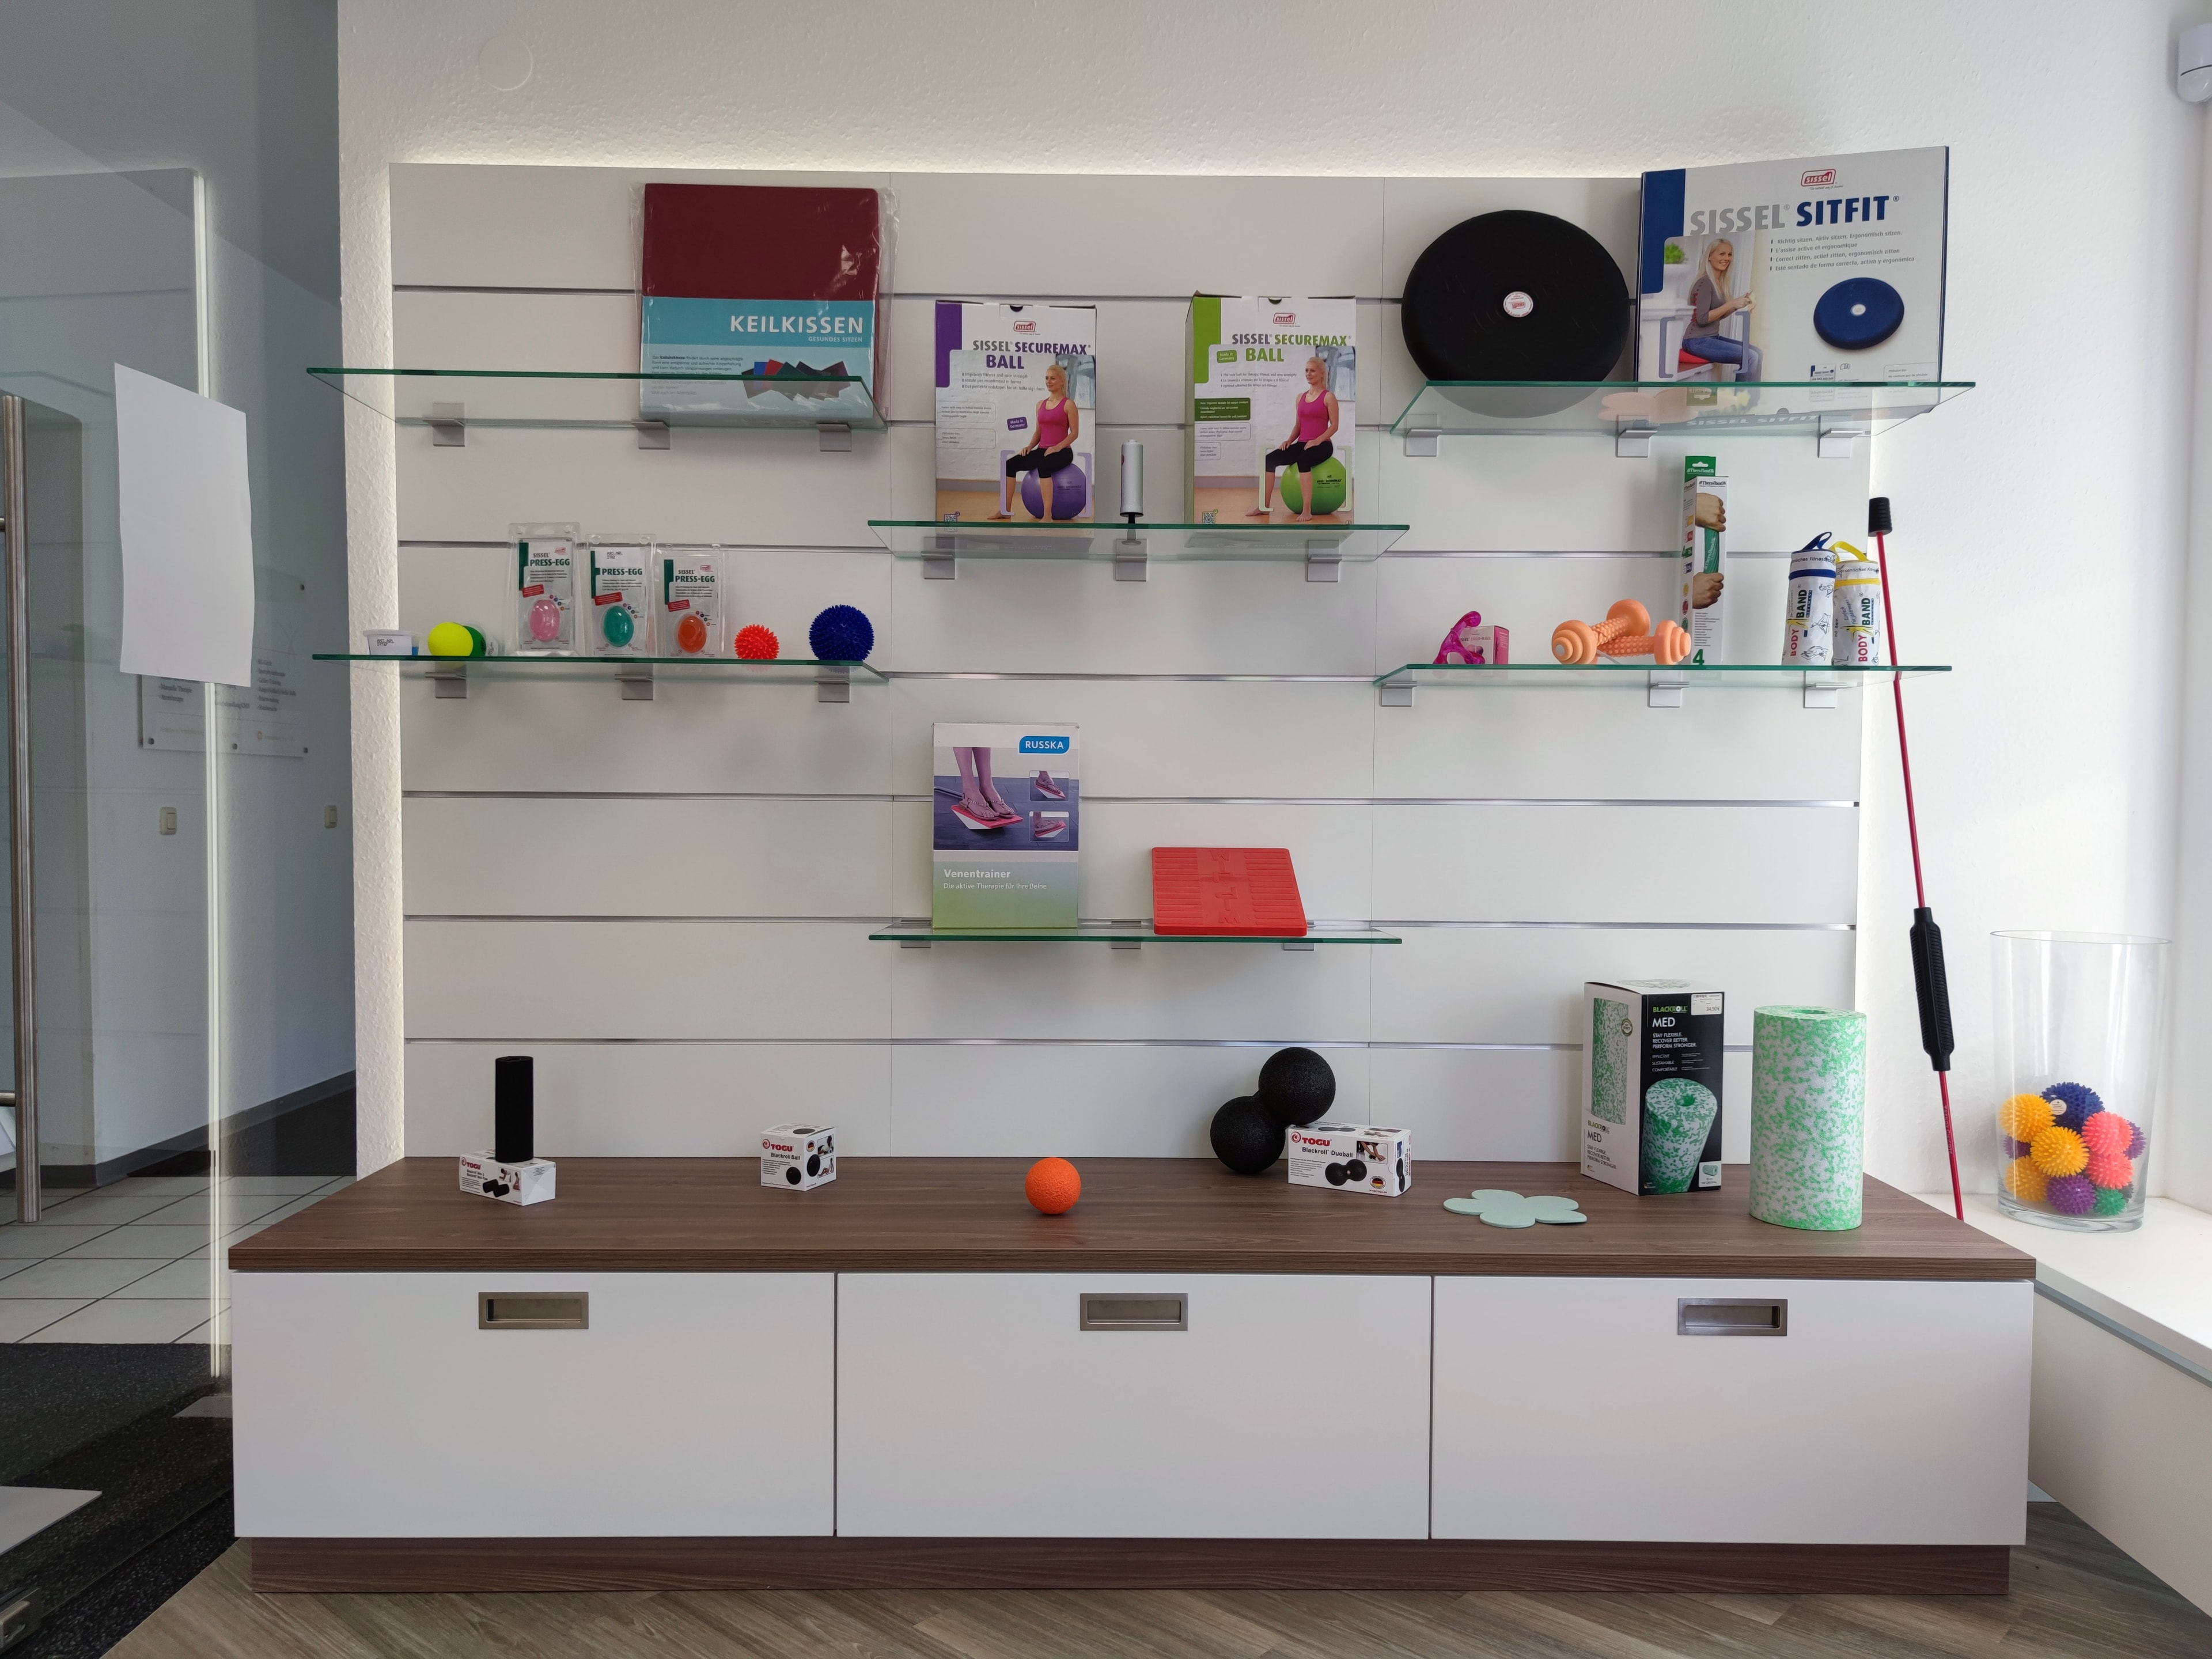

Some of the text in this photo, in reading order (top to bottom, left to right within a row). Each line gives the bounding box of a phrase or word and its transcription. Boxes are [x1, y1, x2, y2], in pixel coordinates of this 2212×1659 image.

[1690, 195, 1889, 236] SISSEL SITFIT
[1849, 231, 1884, 239] Ergonomisch
[1822, 243, 1858, 251] ergonomique
[1883, 256, 1915, 264] ergonómica
[730, 315, 864, 335] KEILKISSEN
[1232, 334, 1347, 346] SISSEL SECUREMAX
[973, 340, 1088, 355] SISSEL SECUREMAX
[1245, 348, 1285, 362] BALL
[986, 354, 1025, 370] BALL
[1790, 629, 1799, 656] BODY
[1796, 589, 1807, 618] BAND
[1858, 597, 1870, 662] BODY BAND
[1692, 649, 1705, 665] 4
[1025, 740, 1064, 749] RUSSKA
[943, 869, 1011, 878] Venentrainer
[1652, 1017, 1676, 1028] MED
[1588, 1120, 1610, 1132] BLACKROLL
[1302, 1137, 1330, 1147] TOGU
[1587, 1130, 1602, 1143] MED
[771, 1144, 793, 1152] TOGU
